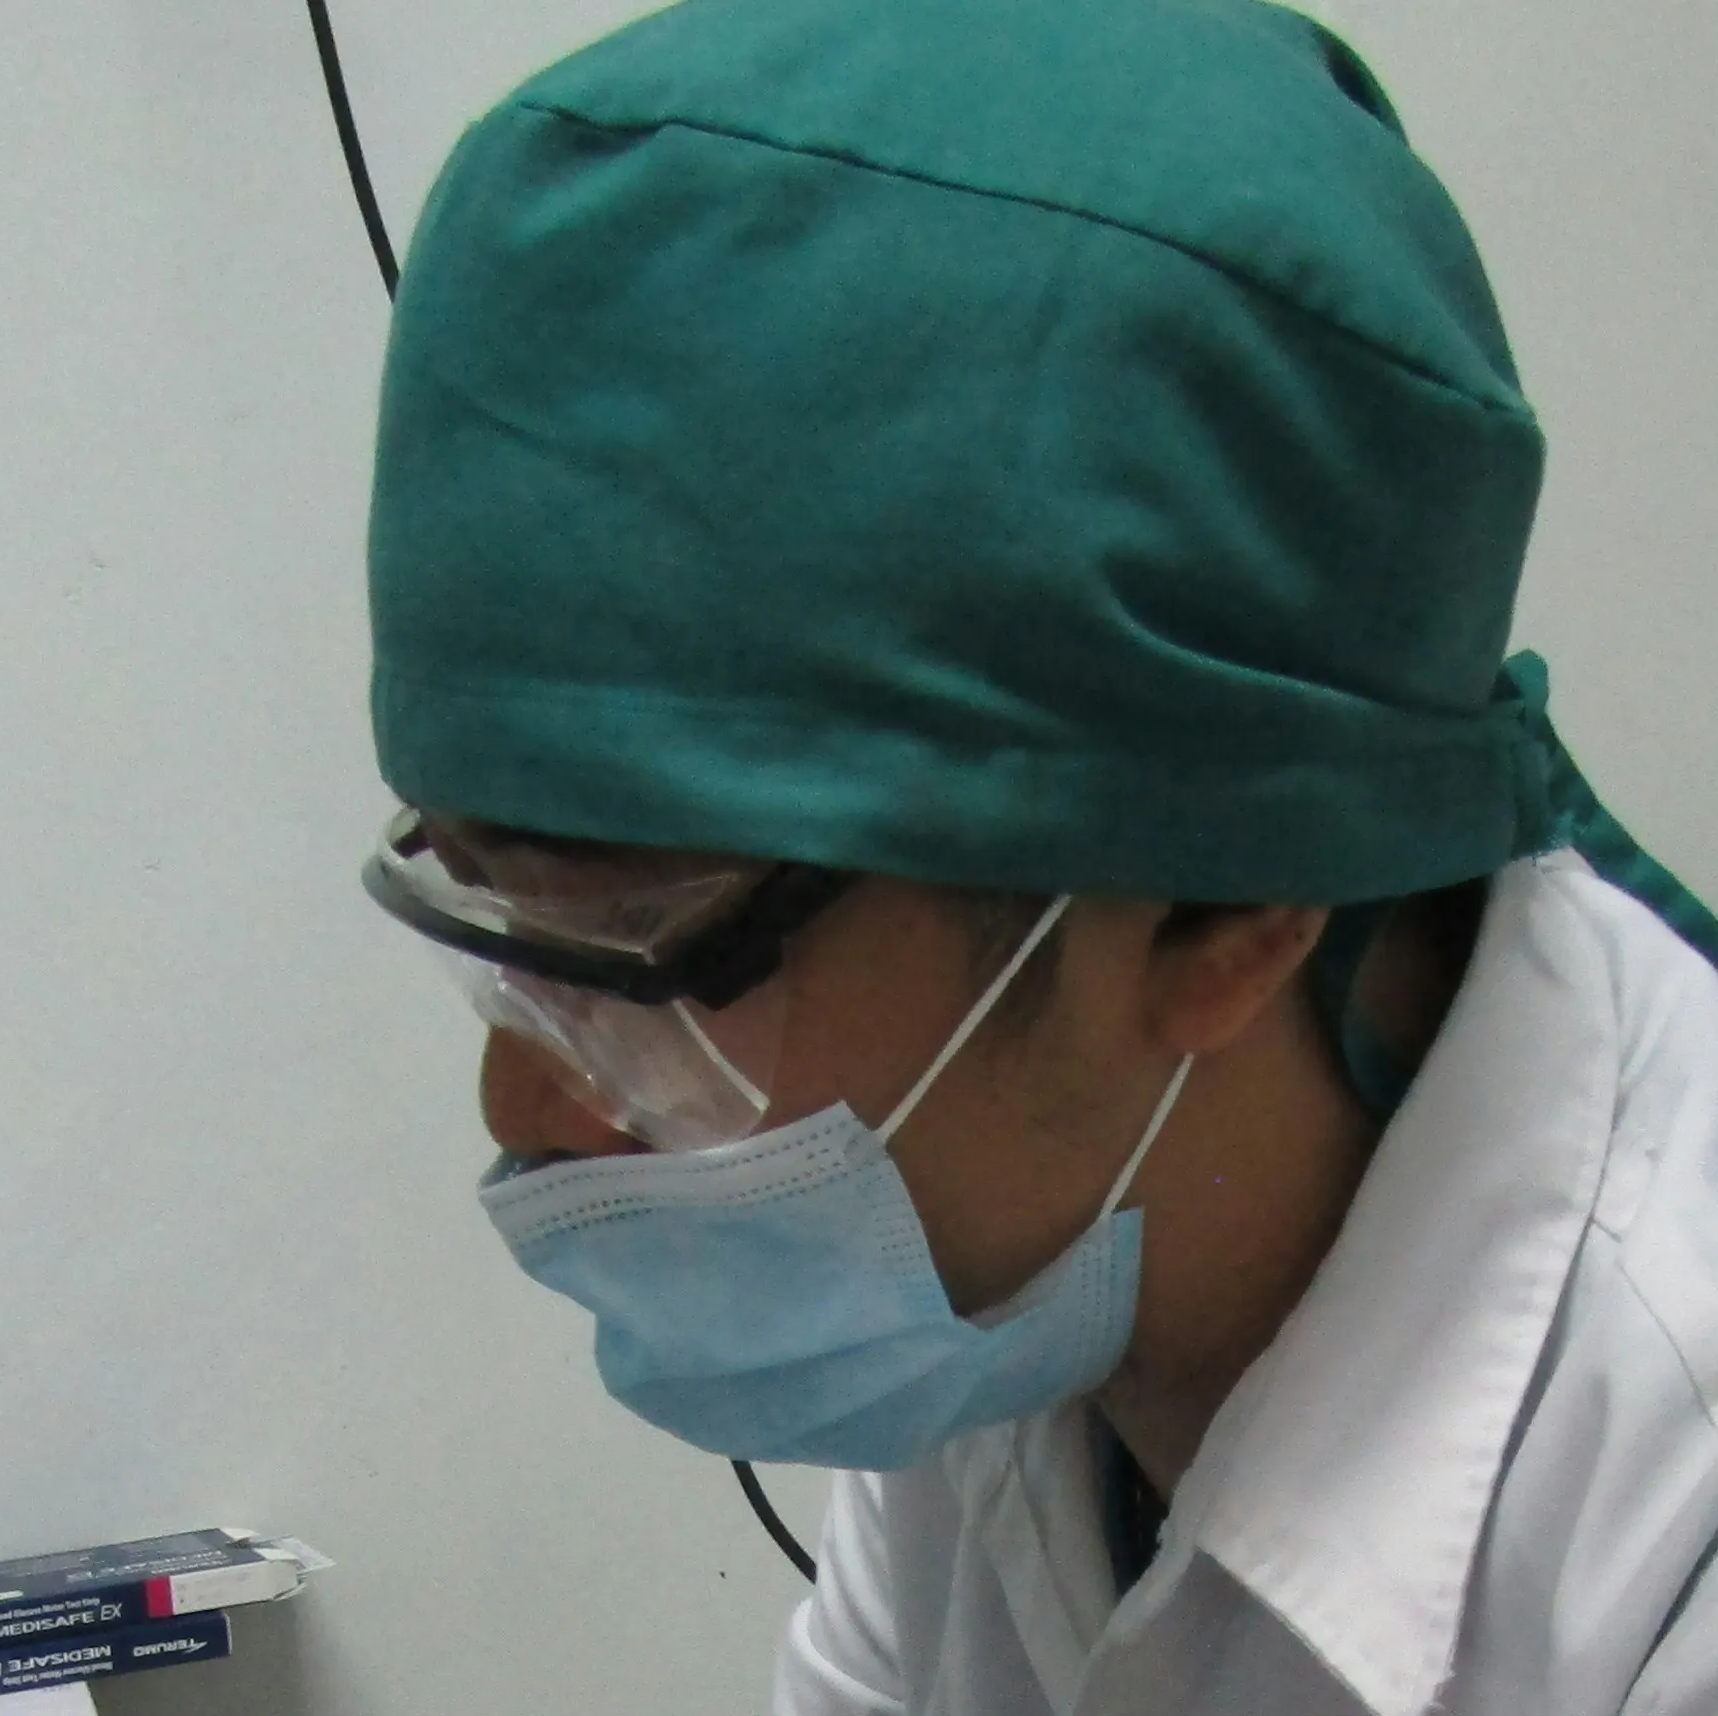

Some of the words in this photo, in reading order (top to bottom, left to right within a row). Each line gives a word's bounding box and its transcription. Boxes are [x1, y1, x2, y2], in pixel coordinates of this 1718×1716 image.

[100, 1602, 123, 1620] EX
[8, 1644, 112, 1667] MEDISAFE
[132, 1637, 207, 1658] TERUMO
